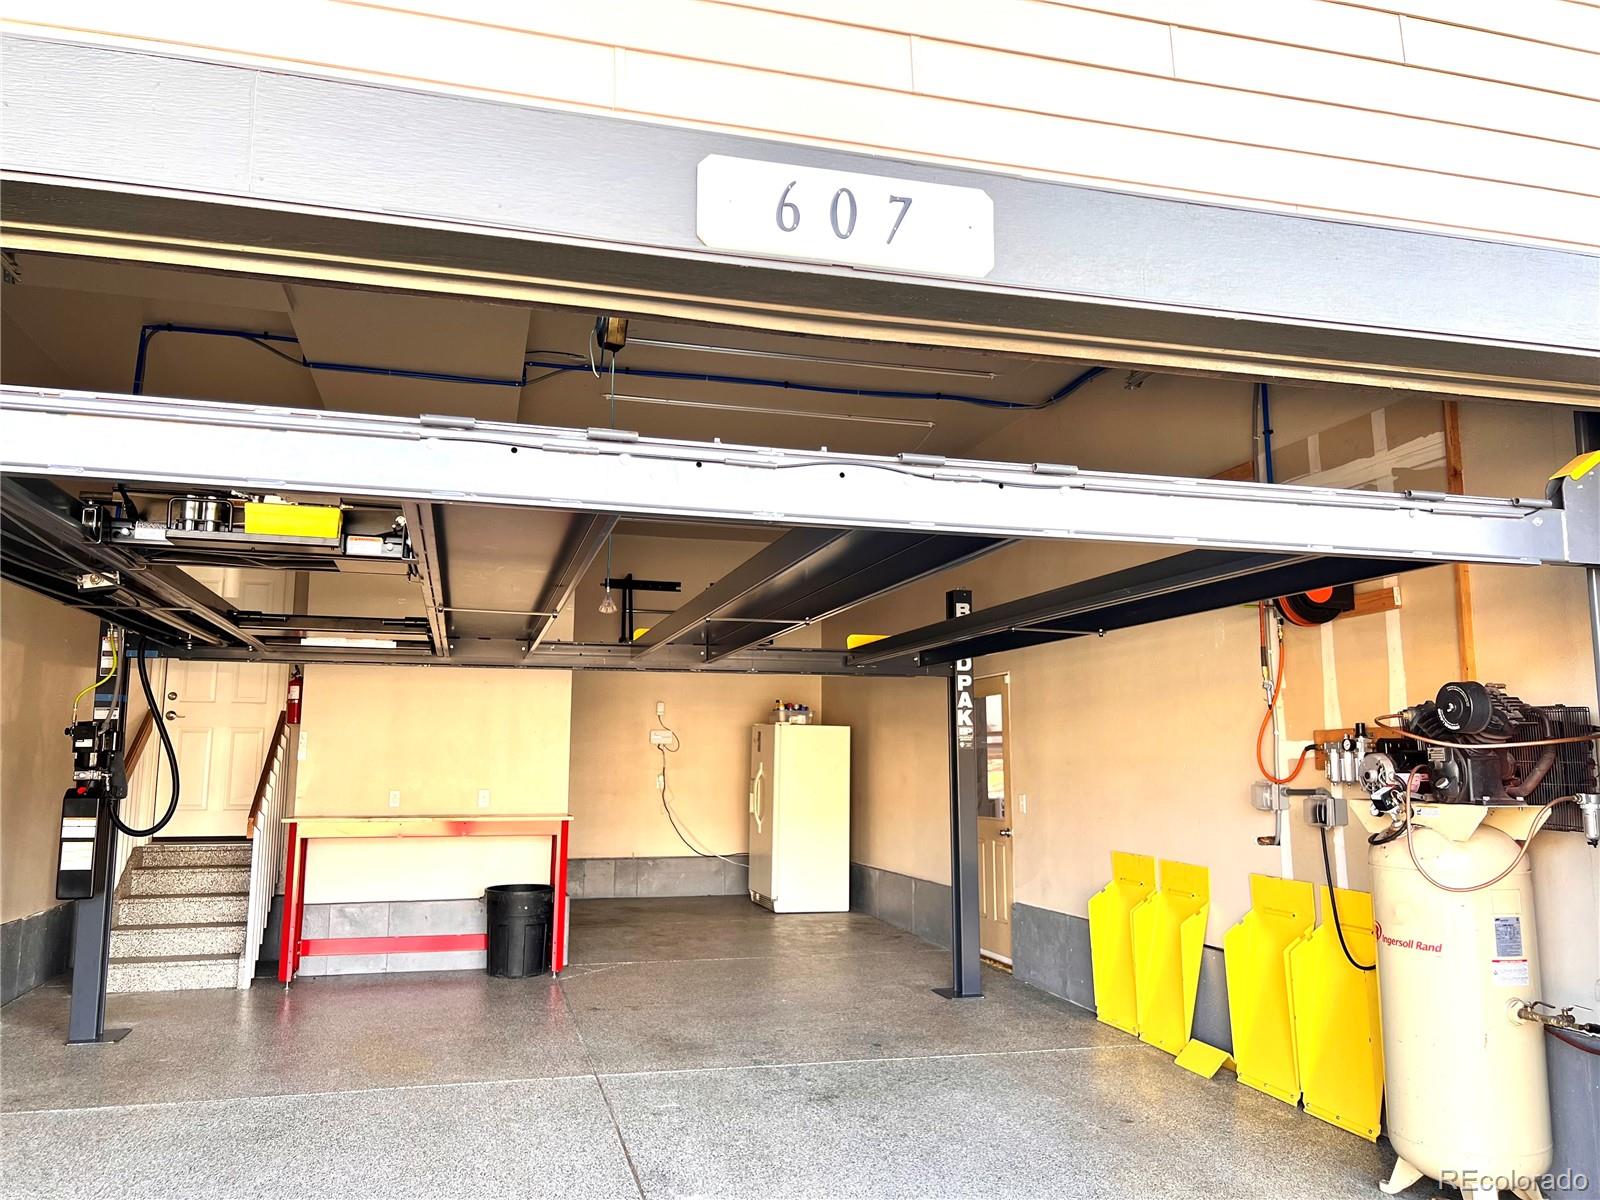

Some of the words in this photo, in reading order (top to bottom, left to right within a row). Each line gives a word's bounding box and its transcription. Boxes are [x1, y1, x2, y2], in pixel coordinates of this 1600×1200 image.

[776, 180, 912, 245] 607
[955, 602, 973, 726] BDPAK
[1381, 934, 1414, 949] Ingersoll
[1415, 941, 1443, 953] Rand
